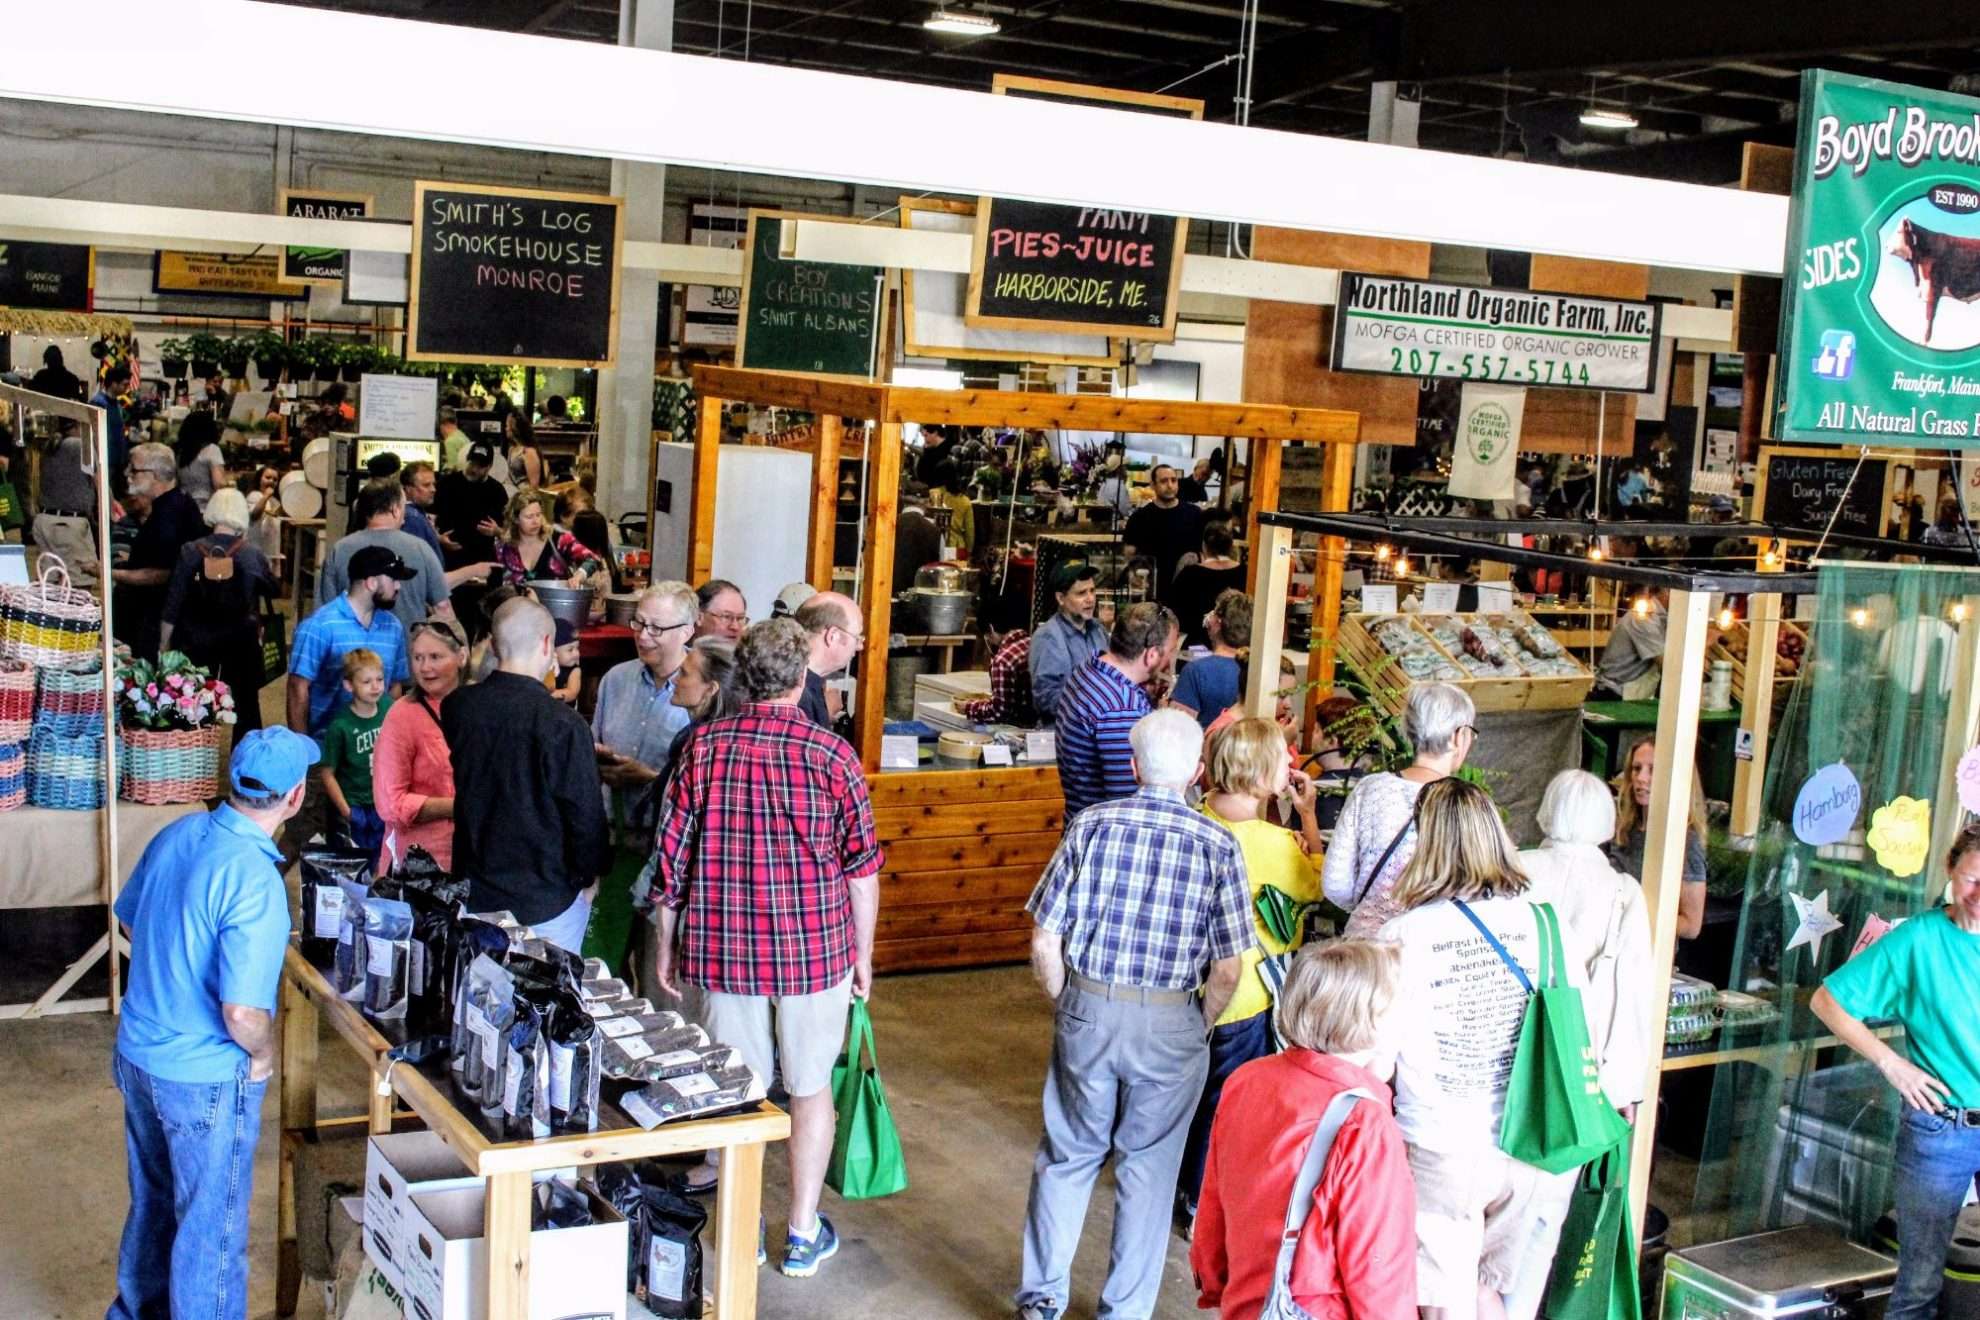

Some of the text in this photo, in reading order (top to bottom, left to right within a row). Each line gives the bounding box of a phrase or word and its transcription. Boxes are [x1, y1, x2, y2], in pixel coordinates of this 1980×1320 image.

[1814, 107, 1898, 180] Boyd
[432, 199, 592, 233] SMITH'S LOG
[1934, 190, 1979, 208] EST 1990
[433, 230, 604, 267] SMOKEHOUSE
[1803, 237, 1860, 290] SIDES
[477, 264, 585, 298] MONROE
[794, 265, 829, 288] BOY
[994, 272, 1149, 309] HARBORSIDE, ME.
[766, 279, 872, 314] CREATIONS
[1349, 276, 1654, 335] Northland Organic Farm, Inc.
[760, 308, 799, 328] SAINT
[804, 313, 870, 338] ALBANS
[1355, 322, 1639, 360] MOFGA CERTIFIED ORGANIC GROWER
[1390, 346, 1590, 386] 207-557-5744
[1891, 371, 1945, 399] Frankfort,
[1471, 417, 1507, 429] CERTIFIED
[1816, 402, 1845, 429] All
[1851, 405, 1916, 433] Natural
[1921, 409, 1969, 437] Grass
[1771, 460, 1821, 482] Gluten
[1843, 506, 1868, 524] Free
[1432, 937, 1471, 952] Belfast
